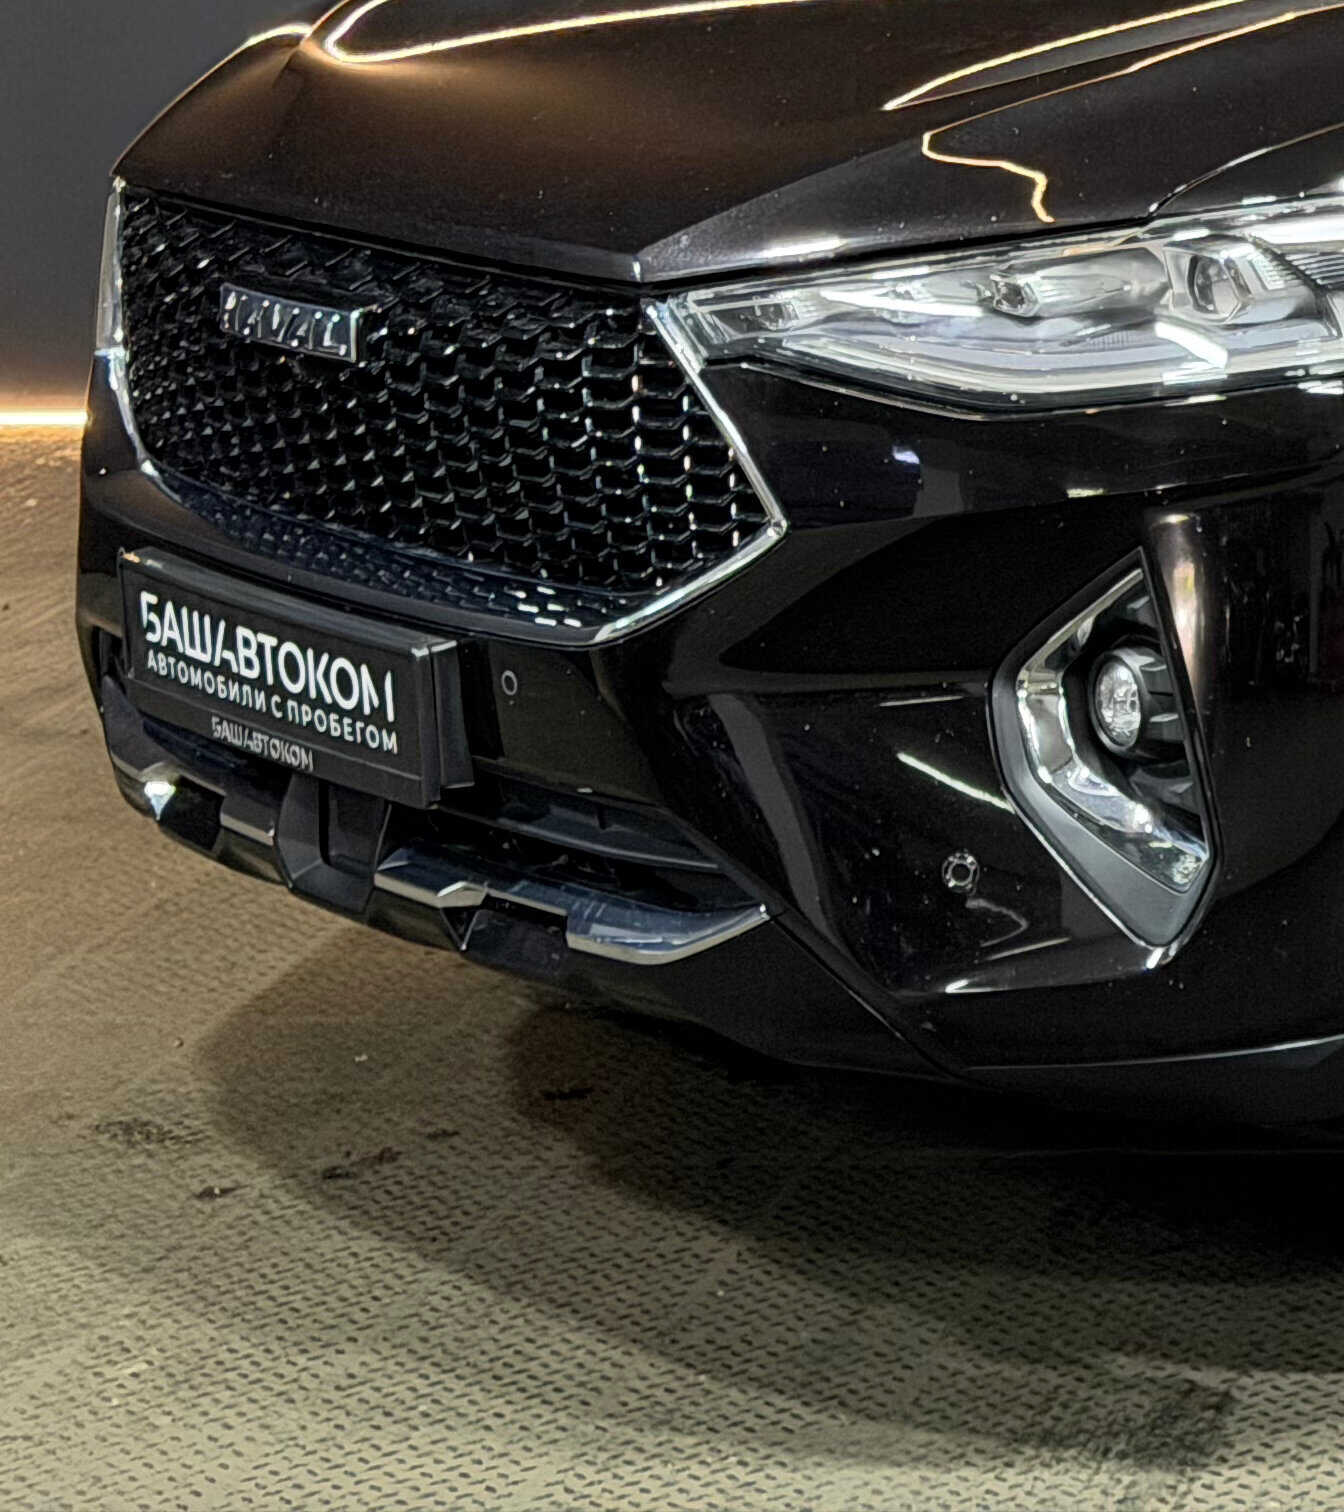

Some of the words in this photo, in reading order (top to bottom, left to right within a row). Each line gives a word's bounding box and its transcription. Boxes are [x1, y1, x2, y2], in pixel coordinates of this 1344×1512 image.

[140, 591, 395, 722] БАШАВТОКОМ
[147, 649, 266, 712] АВТОМОБИЛИ
[271, 694, 283, 718] С
[286, 700, 398, 754] ПРОБЕГОМ
